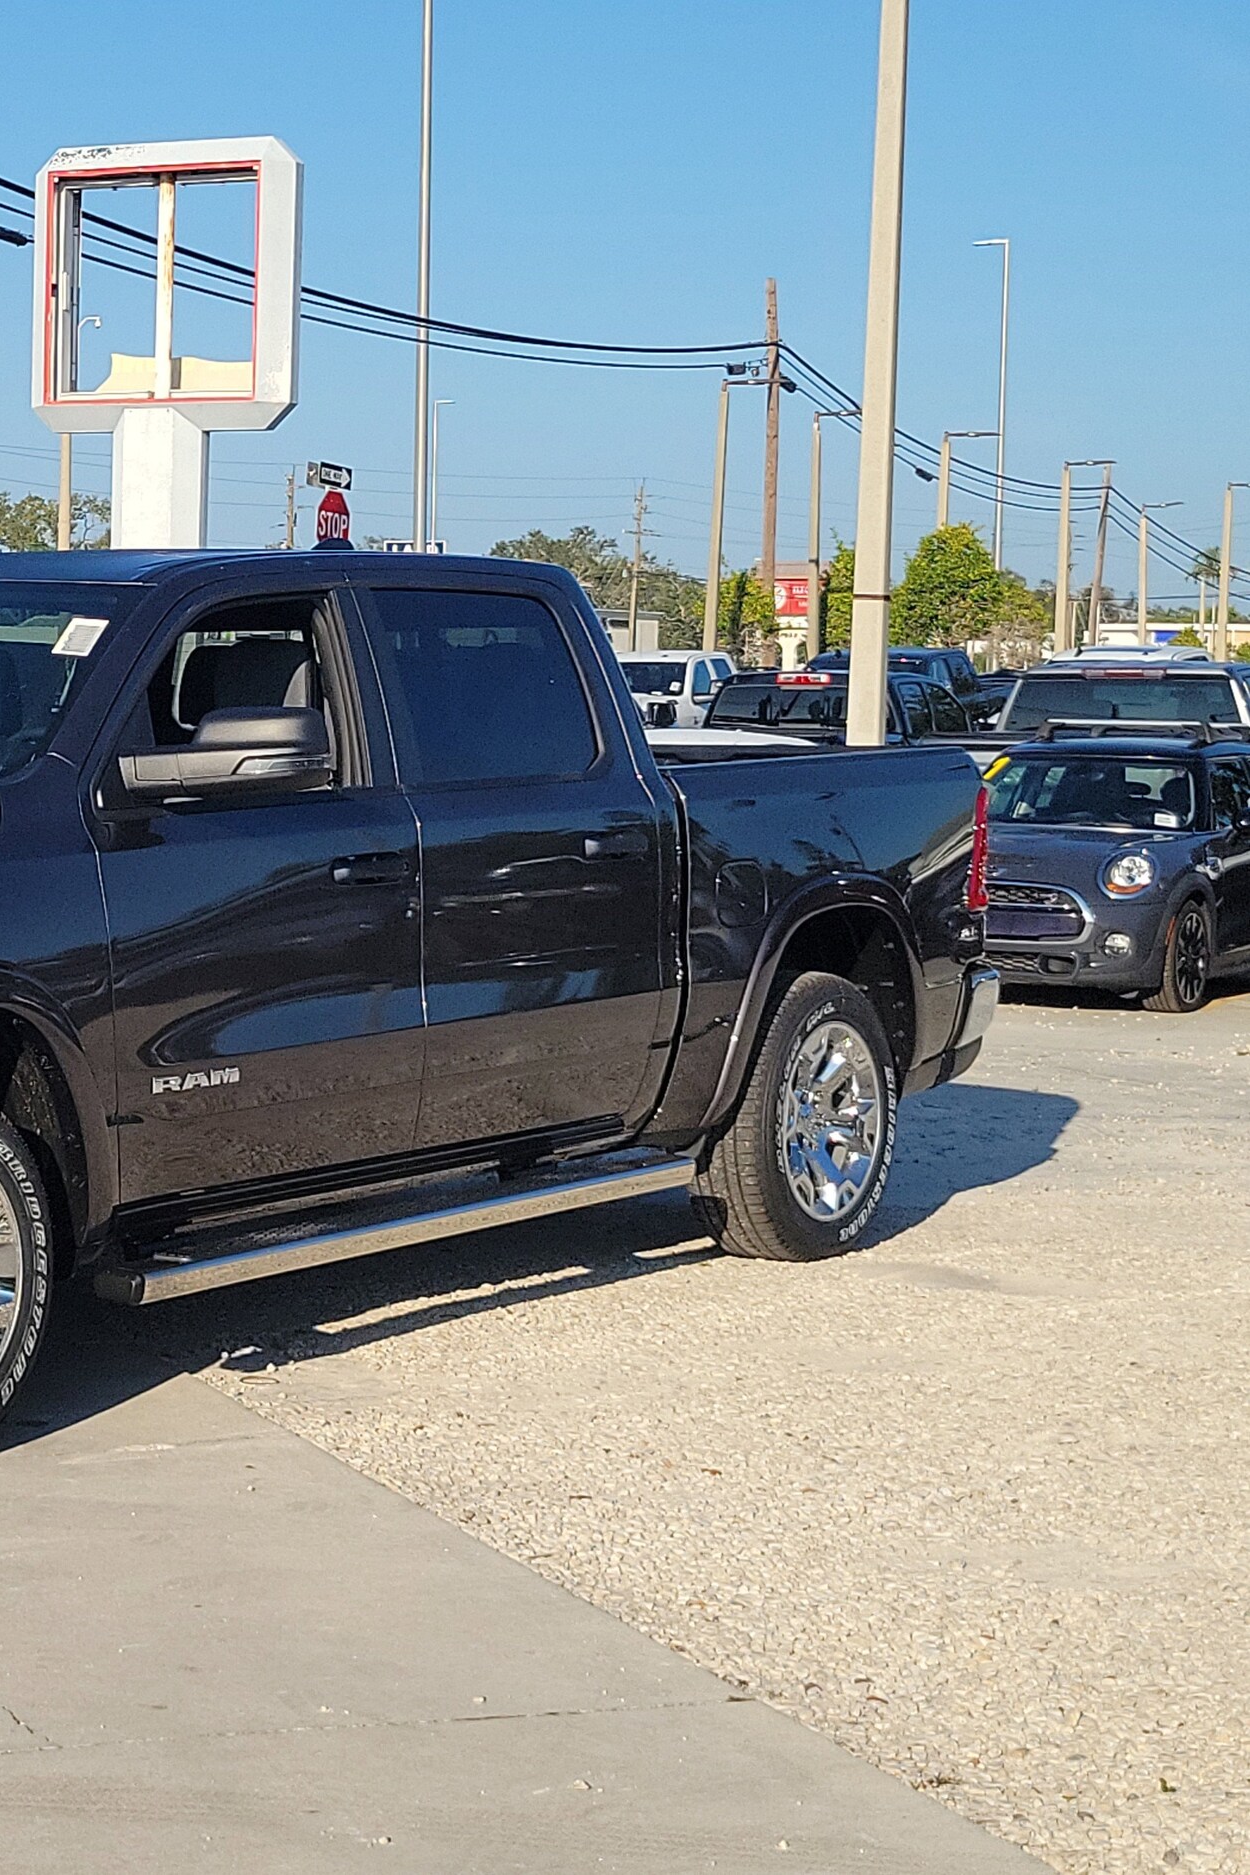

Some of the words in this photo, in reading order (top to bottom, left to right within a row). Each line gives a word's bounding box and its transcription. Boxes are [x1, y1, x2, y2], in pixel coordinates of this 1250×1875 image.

[323, 468, 332, 479] ONE
[318, 510, 348, 539] STOP
[152, 1067, 240, 1094] RAM
